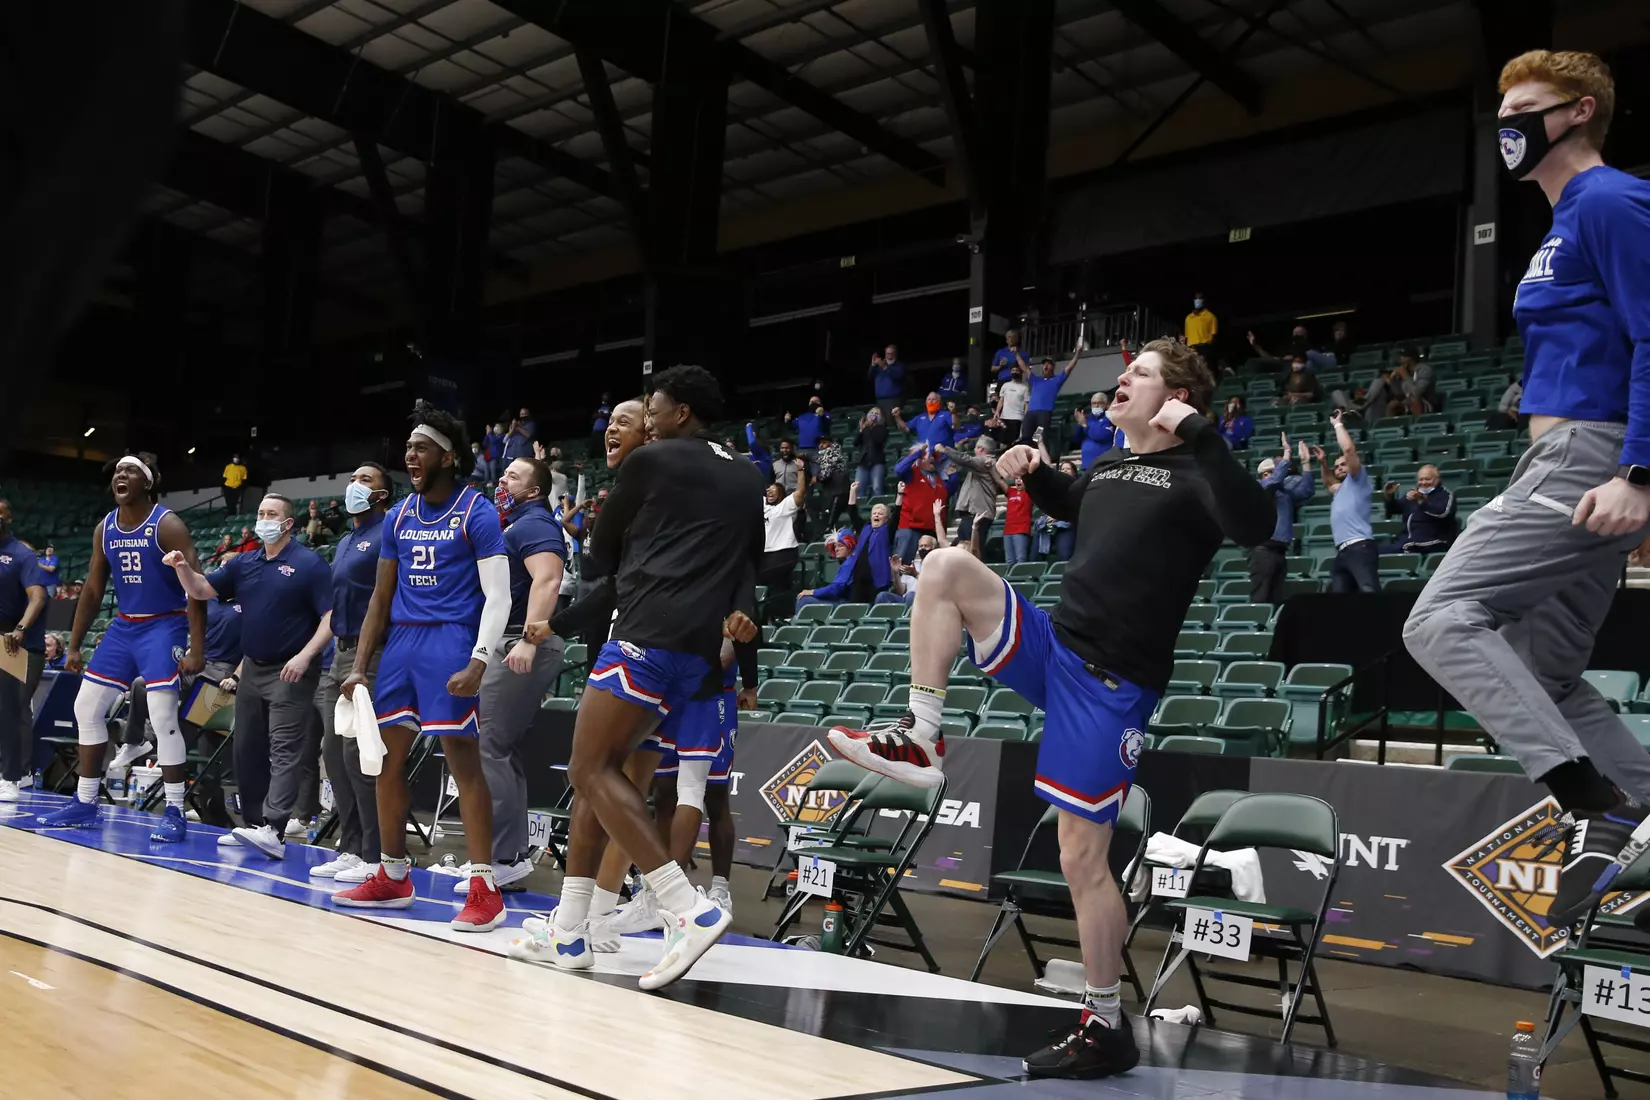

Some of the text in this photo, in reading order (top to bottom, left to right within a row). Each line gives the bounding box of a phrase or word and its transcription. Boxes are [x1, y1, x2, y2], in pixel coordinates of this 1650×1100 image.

[1475, 227, 1493, 240] 107
[109, 538, 149, 550] LOUISIANA
[400, 529, 455, 540] LOUISIANA
[118, 551, 142, 571] 33
[410, 545, 436, 570] 21
[122, 575, 142, 584] TECH
[408, 574, 438, 586] TECH
[770, 752, 813, 789] NATIONAL
[784, 784, 838, 810] NIT
[529, 820, 546, 839] DH
[1466, 813, 1545, 865] NATIONAL
[802, 864, 828, 888] #21
[1157, 872, 1186, 891] #11
[1495, 857, 1562, 895] NI
[1465, 871, 1540, 941] TOURNAMENT
[1600, 892, 1632, 914] EXAS
[823, 917, 835, 932] G
[1193, 917, 1241, 948] #33
[1594, 978, 1650, 1015] #13
